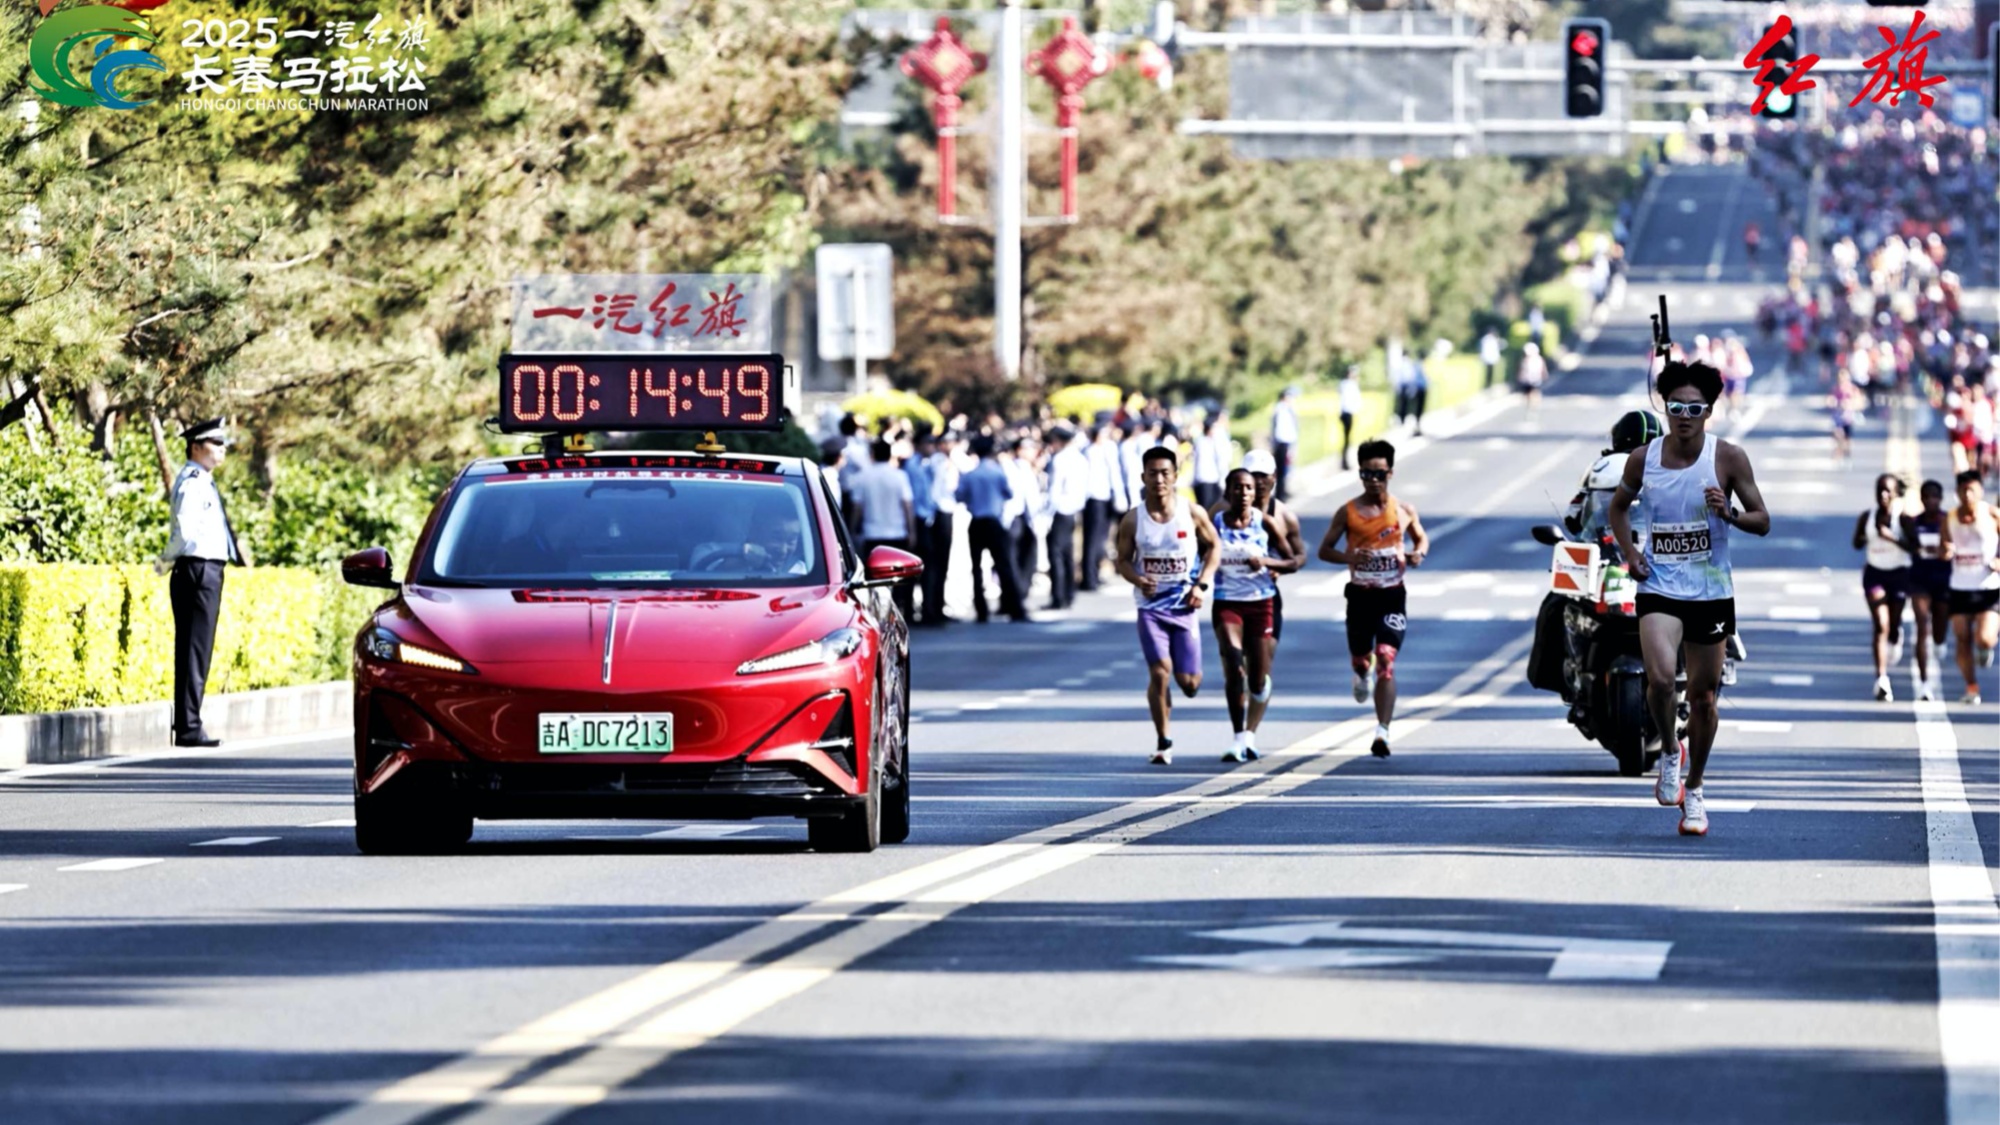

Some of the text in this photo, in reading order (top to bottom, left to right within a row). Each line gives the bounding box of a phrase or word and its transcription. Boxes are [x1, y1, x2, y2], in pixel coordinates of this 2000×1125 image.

[533, 282, 747, 338] 一汽红旗
[1655, 535, 1708, 552] A00520
